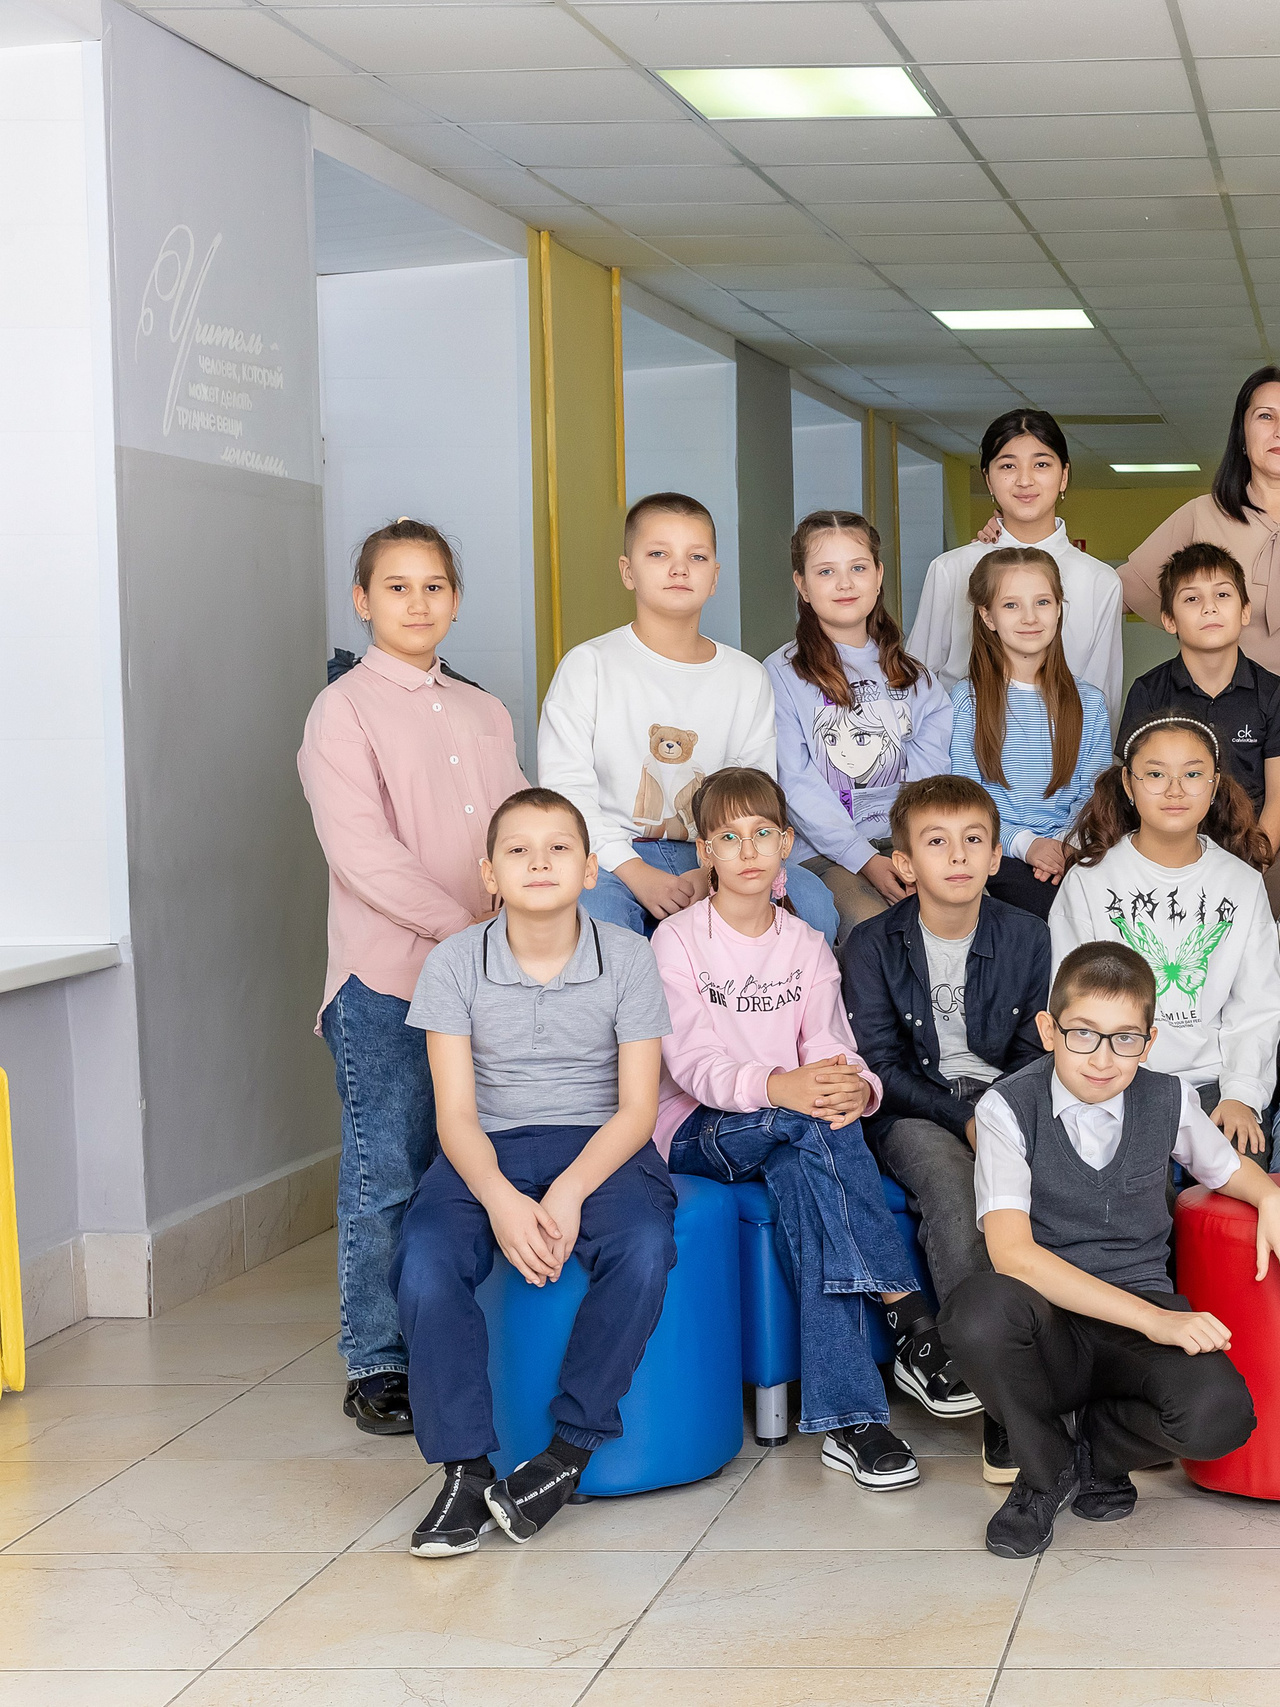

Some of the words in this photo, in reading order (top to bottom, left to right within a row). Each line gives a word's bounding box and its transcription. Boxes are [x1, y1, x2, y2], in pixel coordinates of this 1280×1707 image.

[242, 362, 284, 390] который
[216, 414, 243, 440] вещи
[709, 988, 728, 1009] BIG
[736, 985, 802, 1013] DREAMS
